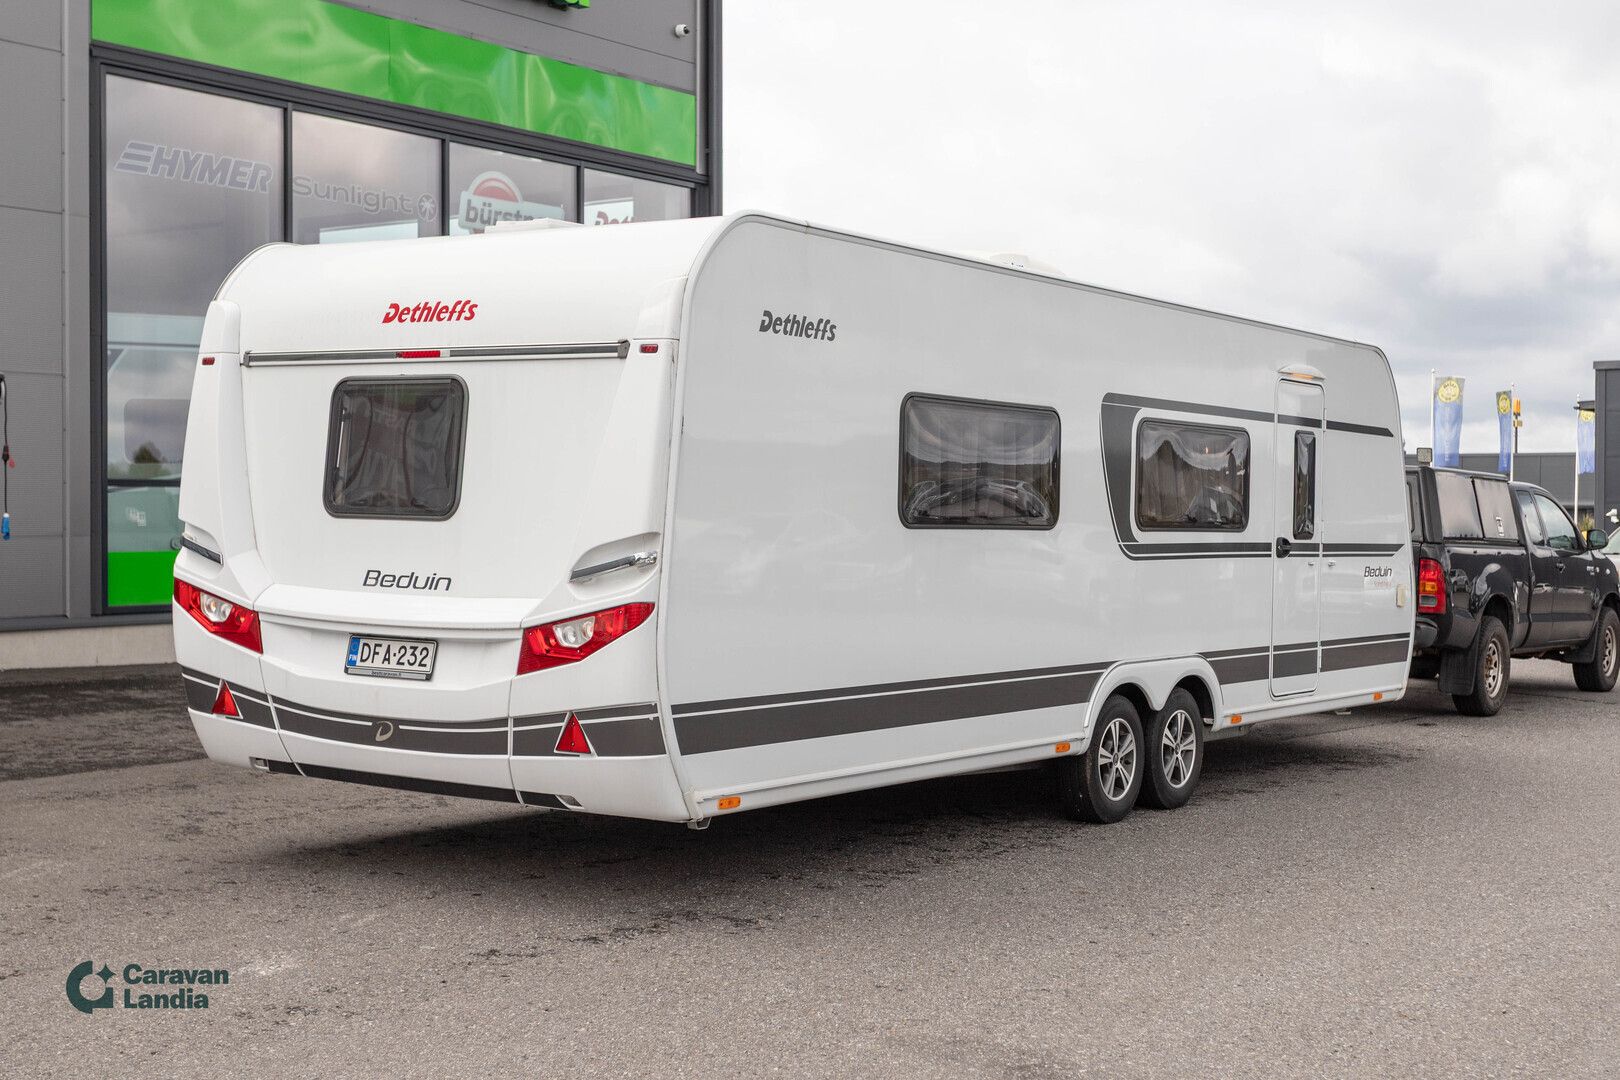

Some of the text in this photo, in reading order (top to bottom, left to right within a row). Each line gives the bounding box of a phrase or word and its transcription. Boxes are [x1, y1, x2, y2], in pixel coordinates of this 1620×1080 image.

[149, 143, 274, 193] HYMER
[292, 175, 414, 214] Sunlight
[382, 299, 479, 324] Dethleffs
[759, 309, 838, 342] Dethleffs
[363, 569, 452, 591] Beduin
[1363, 565, 1393, 578] Beduin
